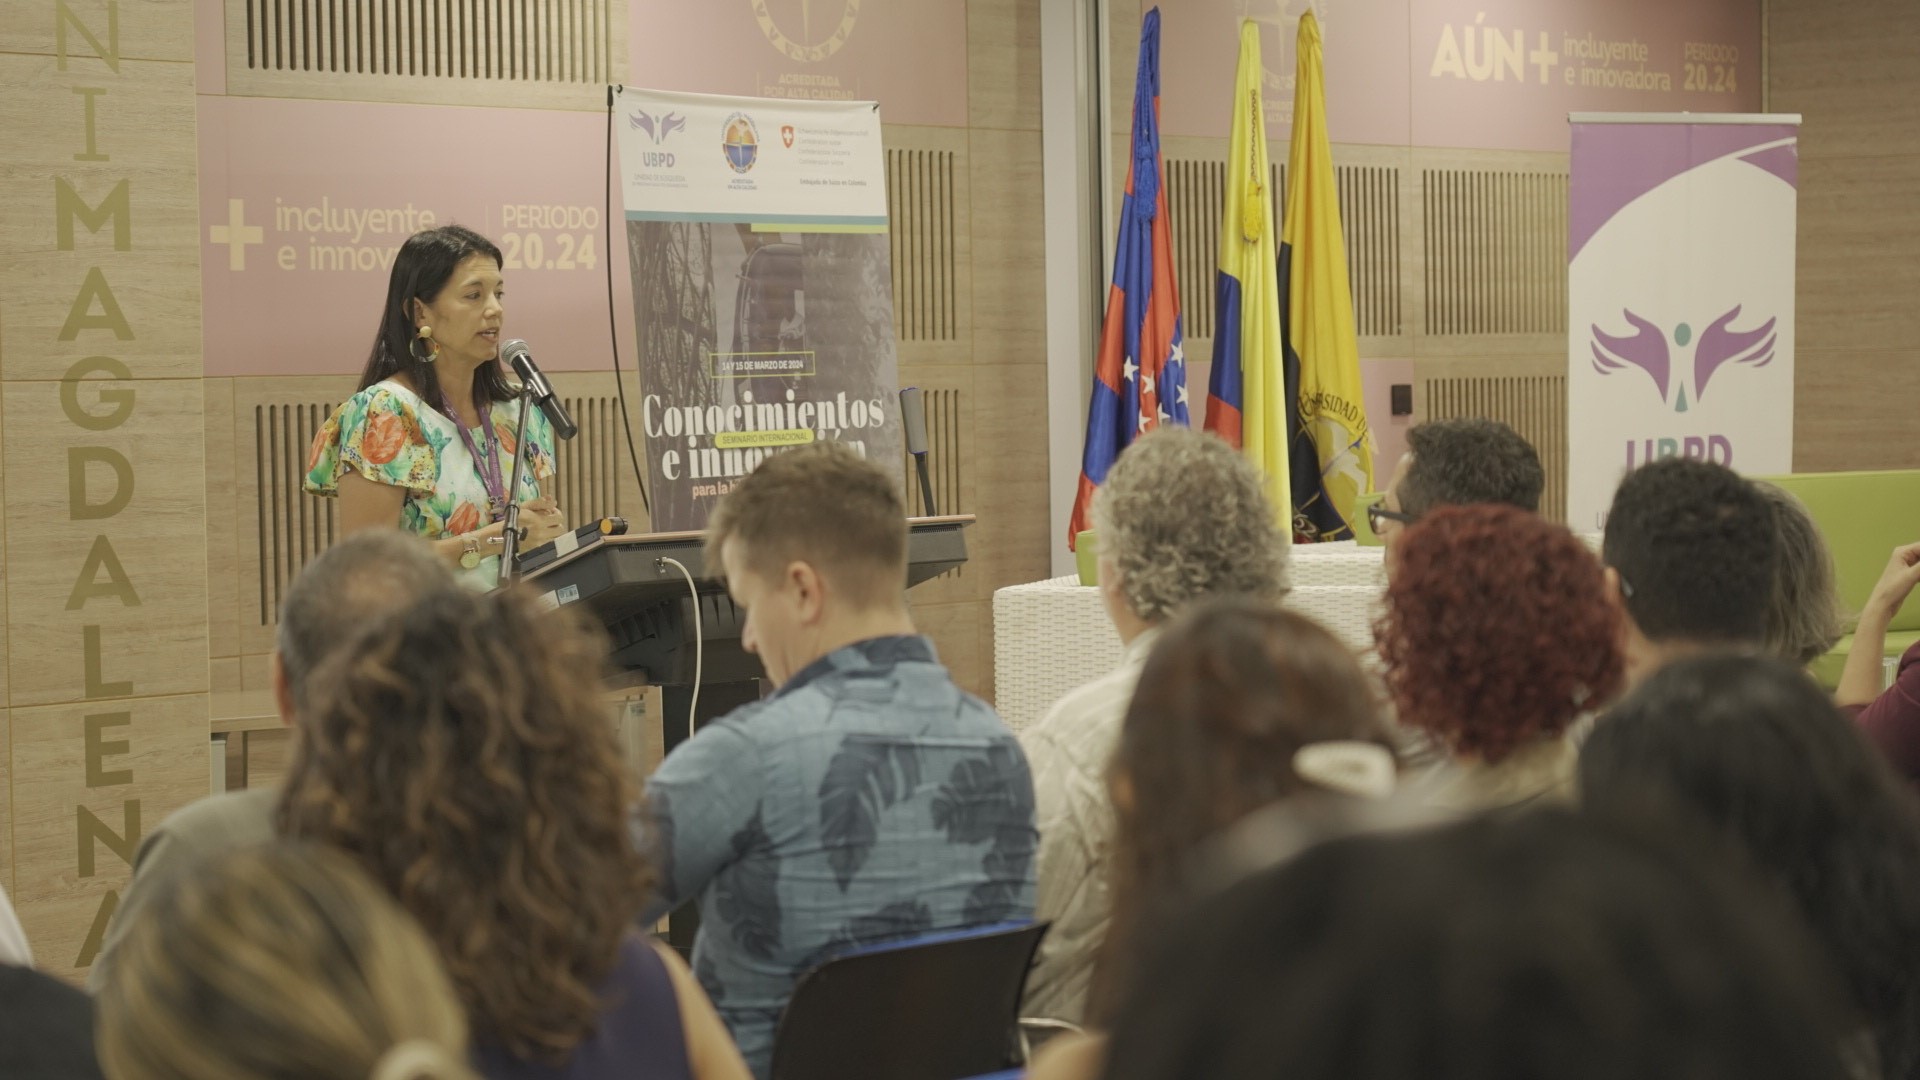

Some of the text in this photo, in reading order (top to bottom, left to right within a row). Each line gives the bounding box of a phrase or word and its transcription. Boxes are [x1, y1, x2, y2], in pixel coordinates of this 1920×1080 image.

[1563, 31, 1649, 67] incluyente
[1684, 42, 1739, 63] PERIODO
[778, 73, 840, 87] ACREDITADA
[1564, 60, 1671, 91] e innovadora
[1684, 62, 1737, 92] 20.24
[643, 152, 675, 168] UBPD
[276, 196, 436, 244] incluyente
[503, 204, 599, 230] PERIODO
[277, 236, 401, 271] e innov
[502, 232, 597, 271] 20.24
[722, 361, 730, 371] 14
[736, 361, 743, 370] 15
[744, 361, 754, 370] DE
[755, 360, 777, 370] MARZO
[779, 360, 787, 369] DE
[788, 359, 804, 369] 2024
[643, 389, 885, 438] Conocimientos
[723, 432, 808, 445] SEMINARIO INTERNACIONAL
[662, 449, 681, 480] e
[692, 482, 717, 500] para
[717, 481, 728, 495] la
